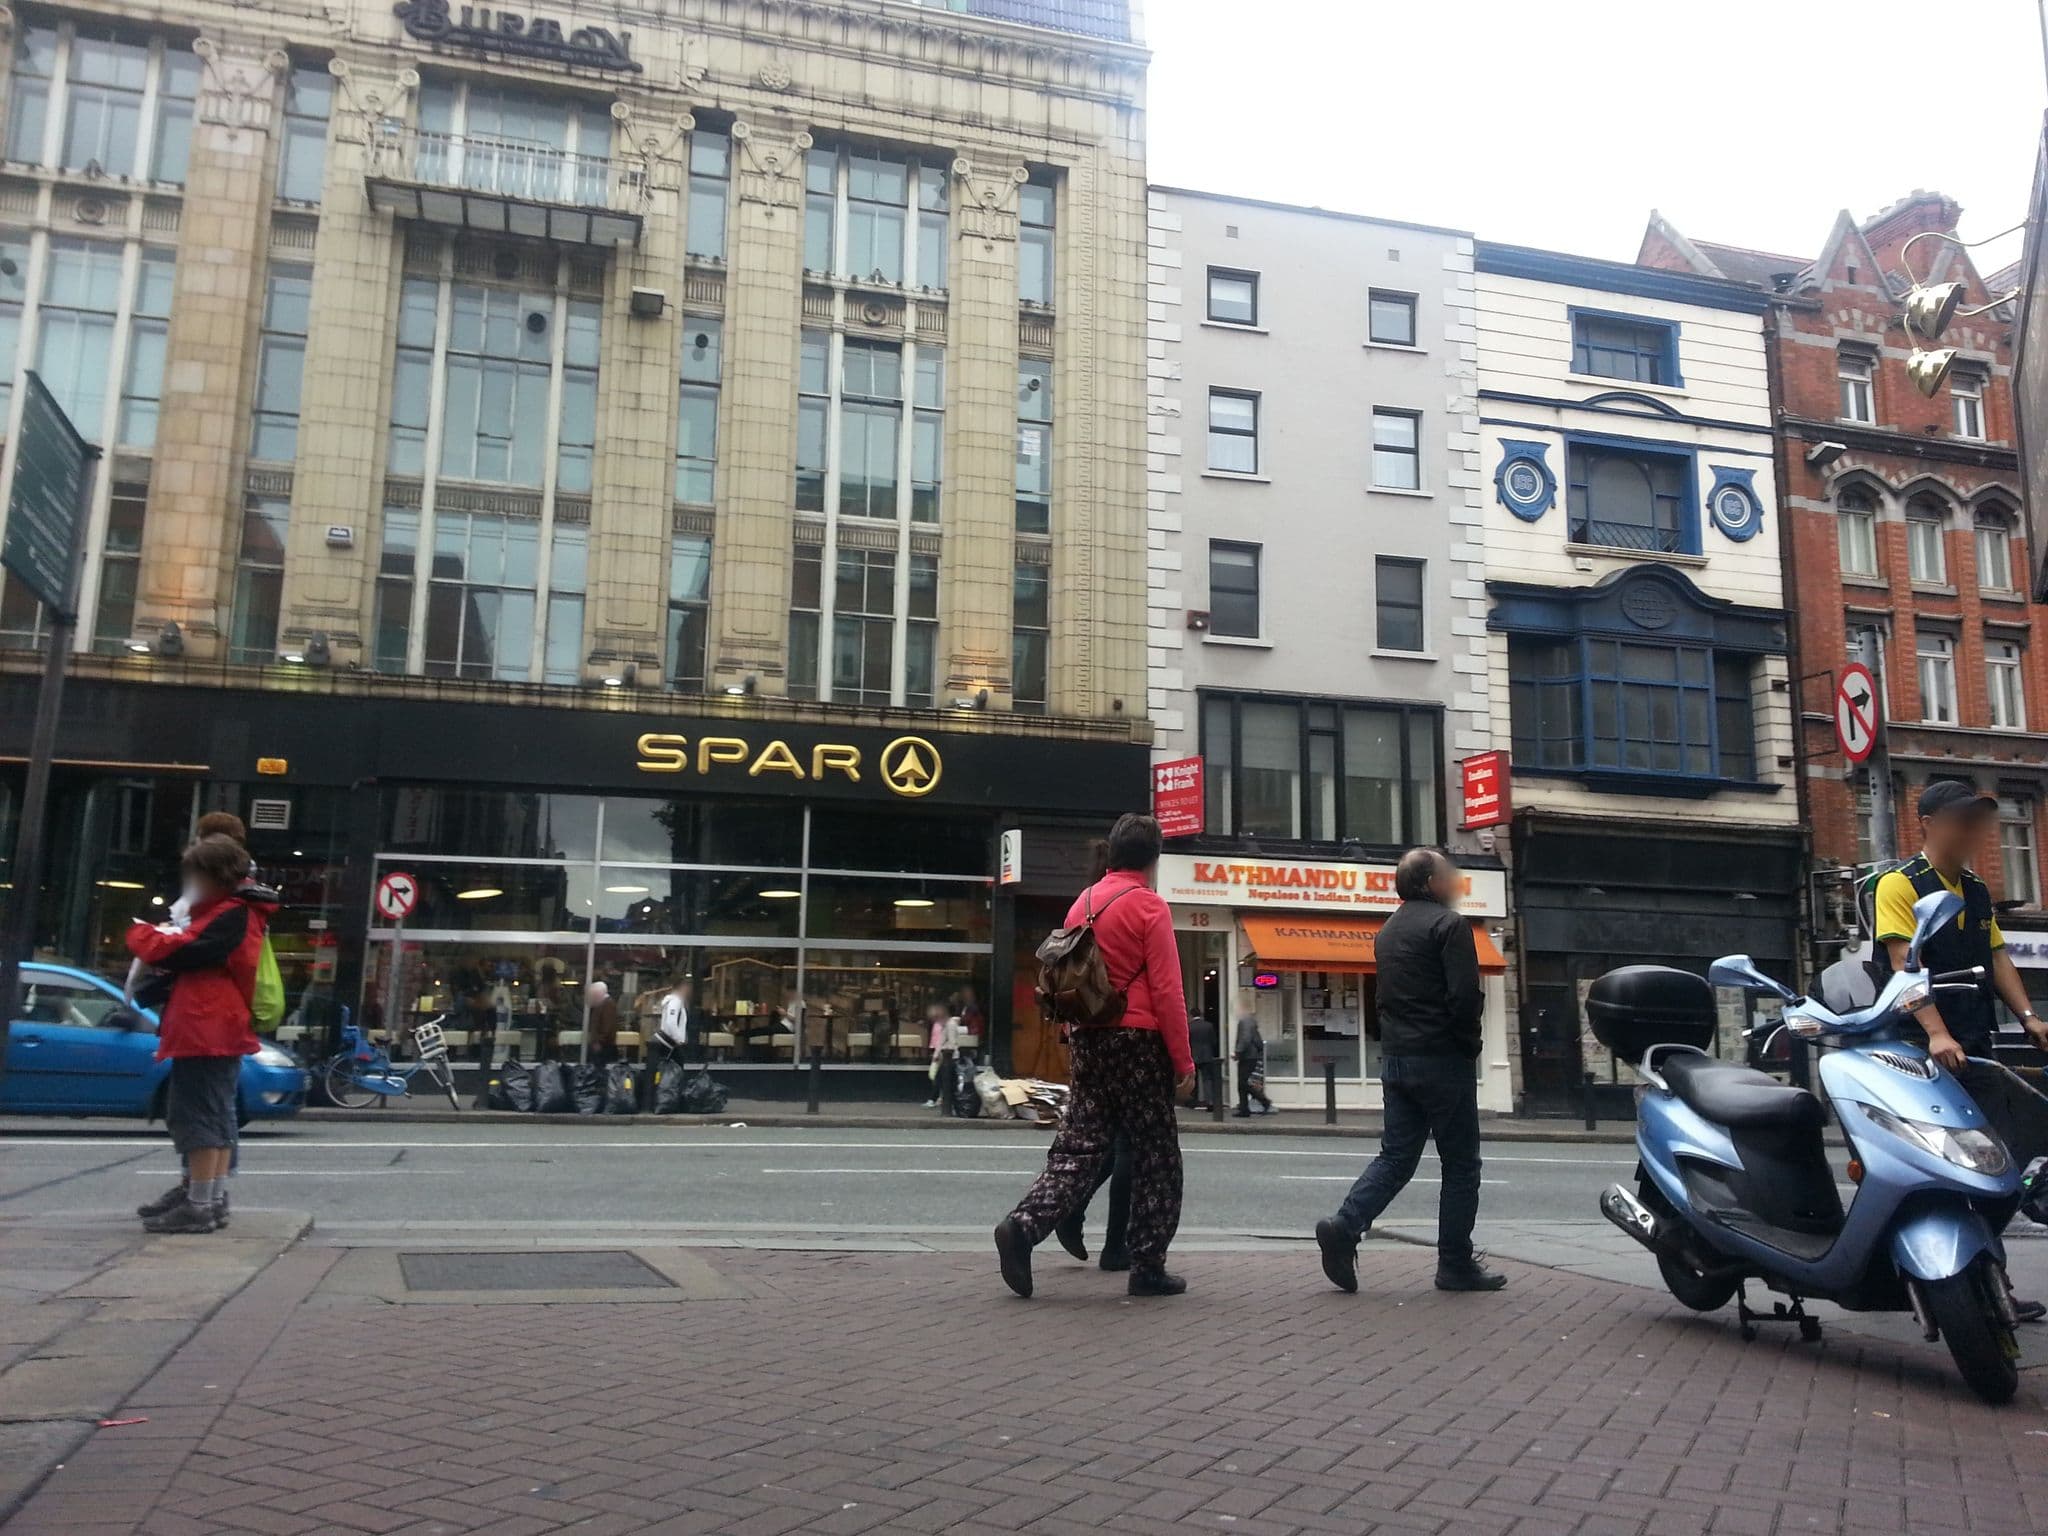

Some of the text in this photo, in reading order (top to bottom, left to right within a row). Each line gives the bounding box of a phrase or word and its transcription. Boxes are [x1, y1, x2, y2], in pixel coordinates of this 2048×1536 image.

[636, 733, 862, 783] SPAR
[1174, 764, 1199, 778] Knight
[1468, 768, 1493, 782] Indian
[1174, 775, 1195, 790] Frank
[1194, 863, 1357, 890] KATHMANDU
[1248, 889, 1300, 902] Nepalese
[1303, 891, 1311, 901] &
[1314, 892, 1351, 903] Indian
[1191, 912, 1210, 927] 18
[1274, 927, 1381, 941] KATHMAND
